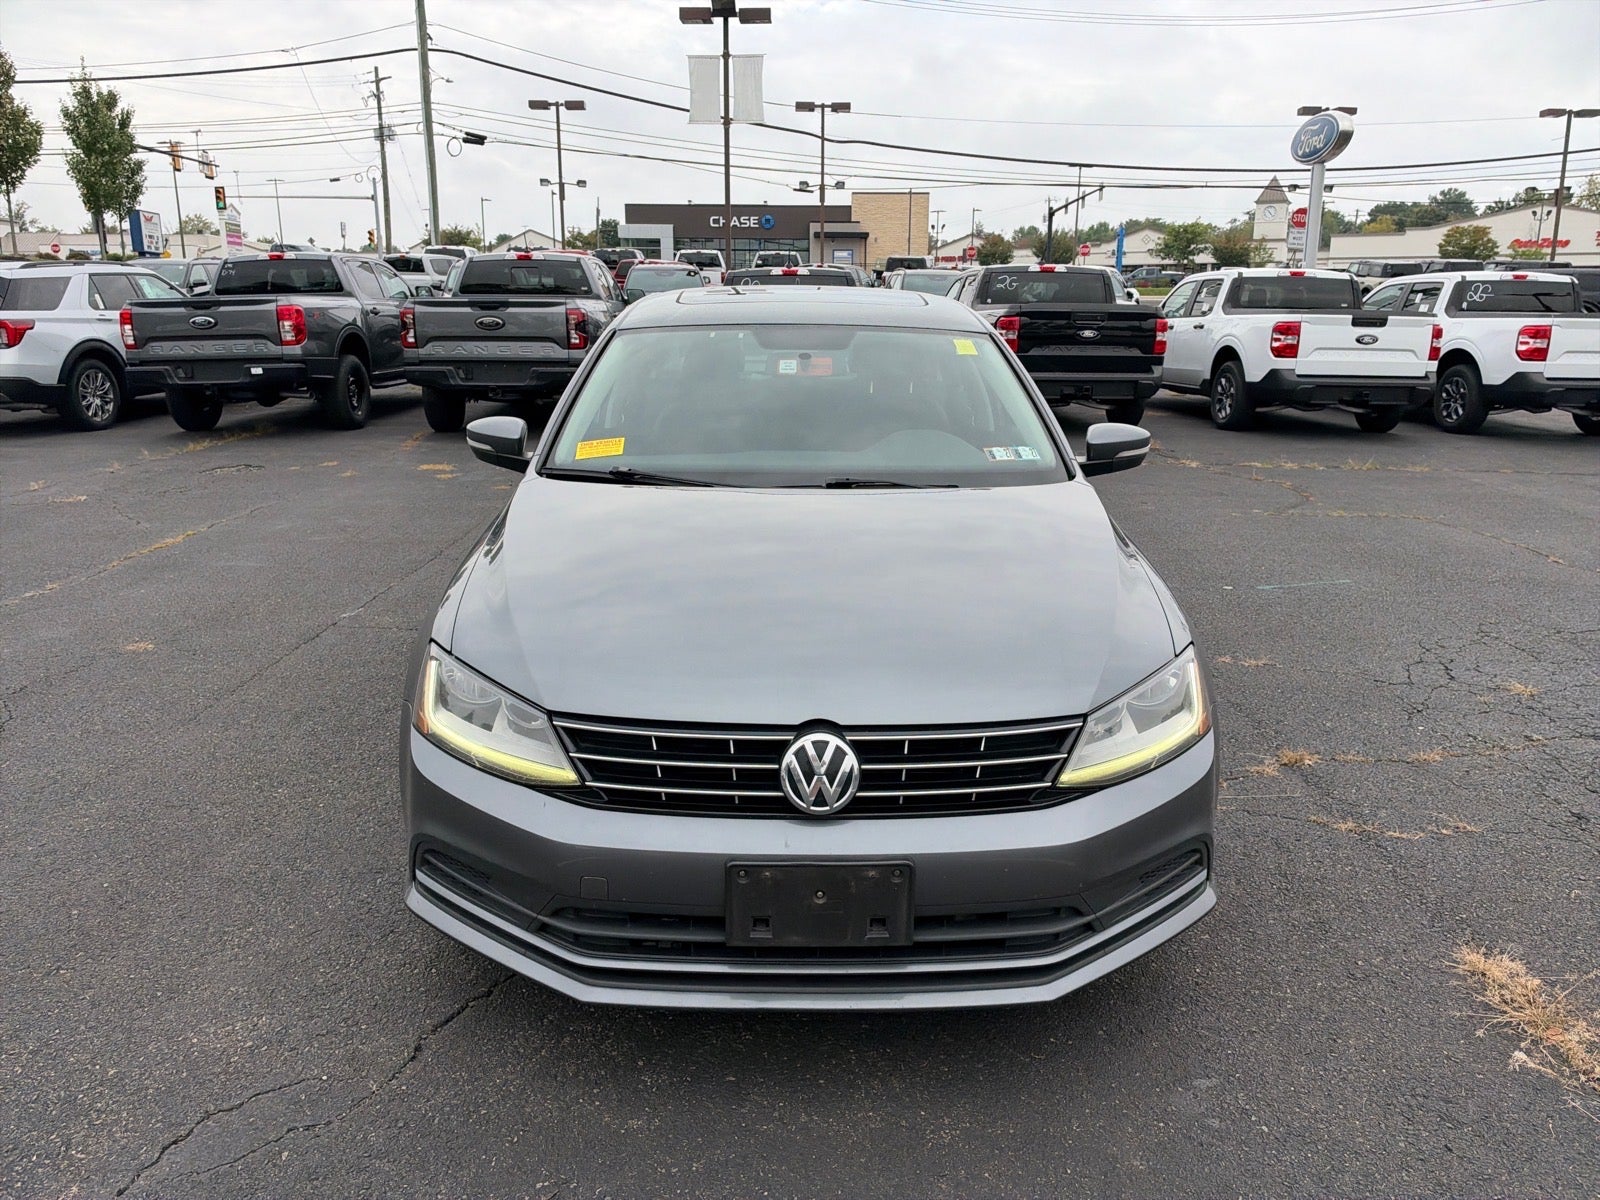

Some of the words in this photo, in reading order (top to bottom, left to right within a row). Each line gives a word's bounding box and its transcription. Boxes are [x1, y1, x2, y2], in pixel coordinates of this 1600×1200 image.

[1297, 123, 1328, 156] Ford
[1292, 213, 1306, 223] STO
[150, 342, 268, 354] RANGER
[431, 345, 556, 355] RANGER
[784, 736, 857, 812] VW
